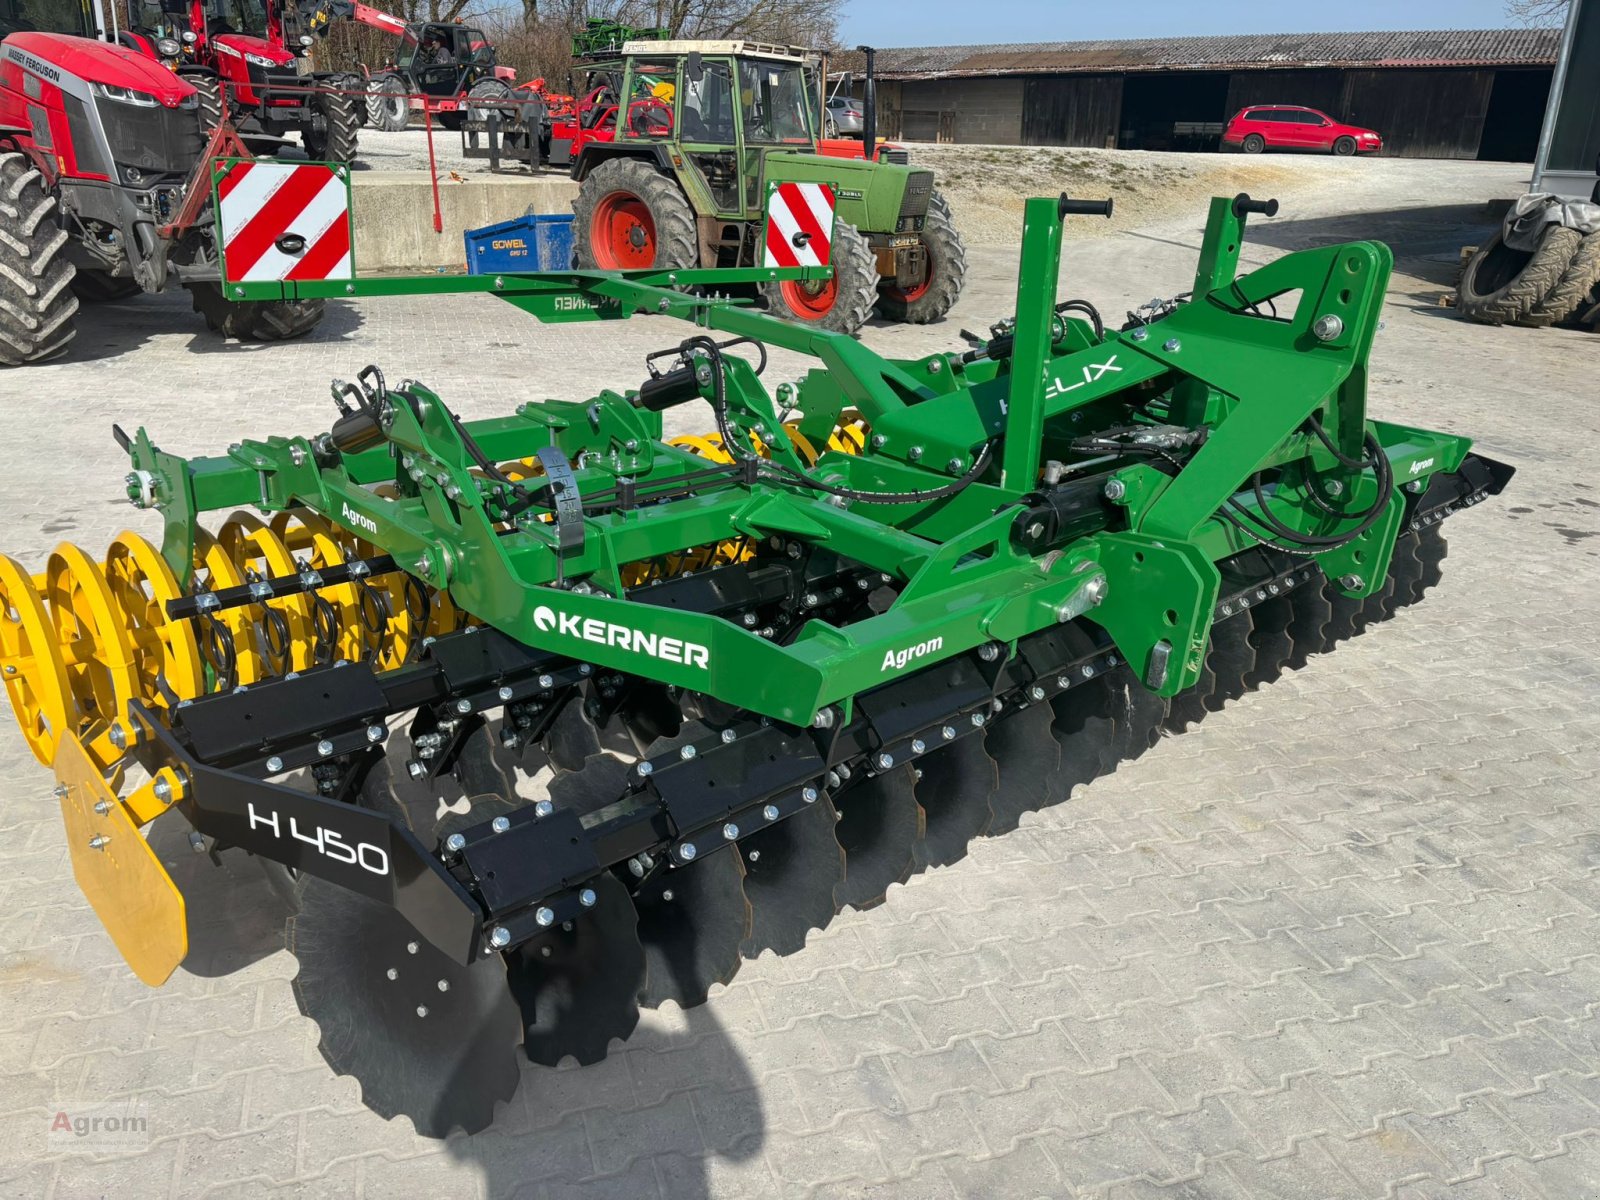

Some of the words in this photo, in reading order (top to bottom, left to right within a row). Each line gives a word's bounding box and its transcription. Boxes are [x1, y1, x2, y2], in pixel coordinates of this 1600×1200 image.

[8, 48, 26, 65] MASSEY
[25, 56, 60, 82] FERGUSON
[556, 467, 563, 475] 5
[1408, 457, 1434, 475] Agrom
[562, 489, 572, 499] 15
[342, 501, 378, 534] Agrom
[558, 611, 709, 670] KERNER
[880, 636, 943, 672] Agrom
[248, 802, 281, 839] H
[289, 816, 389, 876] 450
